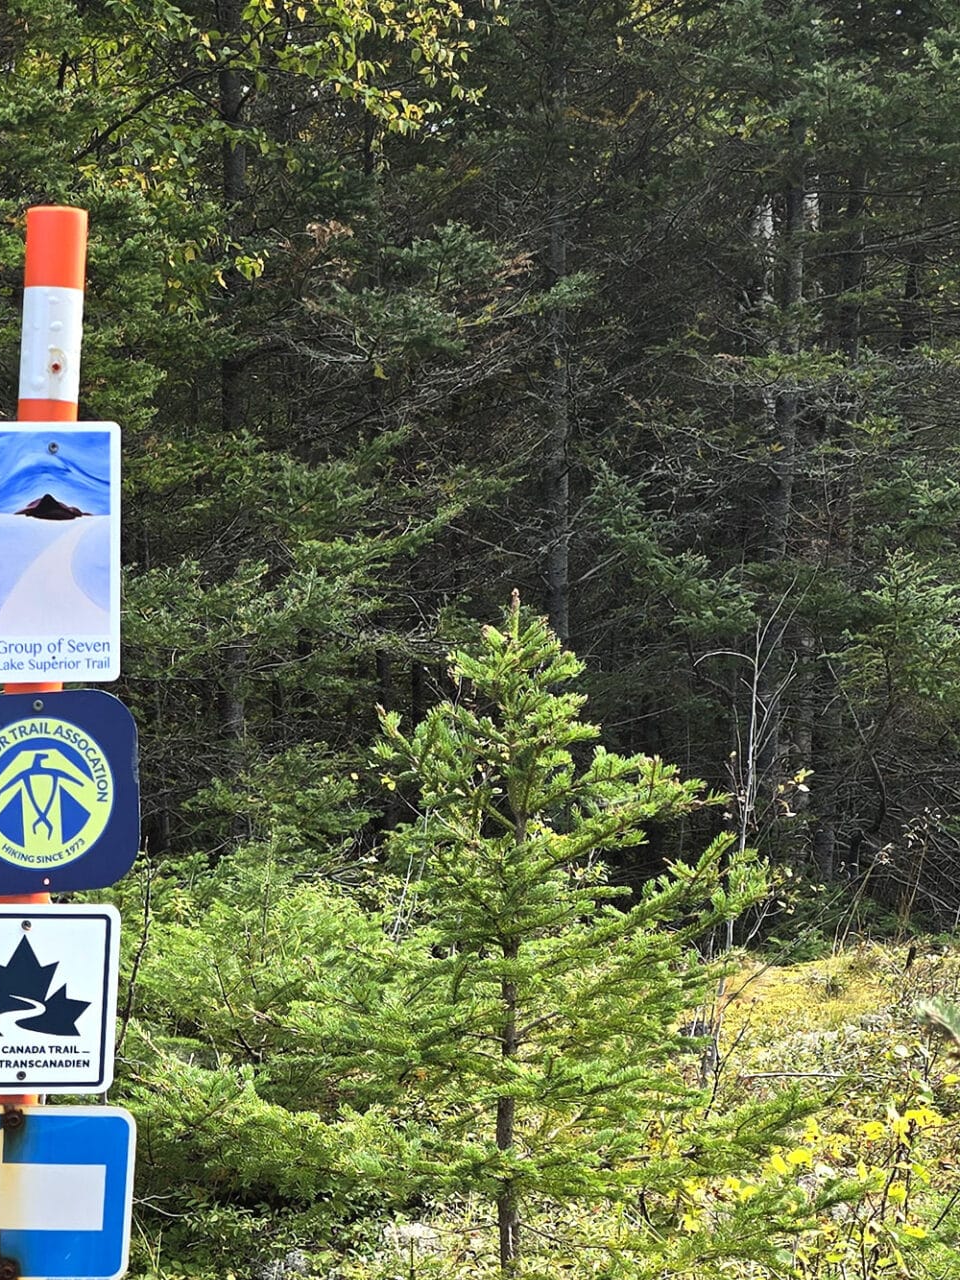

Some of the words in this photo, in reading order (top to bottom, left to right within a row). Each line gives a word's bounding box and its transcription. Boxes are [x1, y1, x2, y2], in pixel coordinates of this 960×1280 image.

[47, 638, 64, 653] of
[67, 639, 110, 653] Seven
[28, 658, 81, 672] Superior
[85, 657, 110, 669] Trail
[8, 722, 50, 740] TRAIL
[1, 843, 34, 863] HIKING
[36, 851, 63, 863] SINCE
[65, 838, 85, 856] 1973
[1, 1045, 46, 1054] CANADA
[48, 1045, 79, 1054] TRAIL
